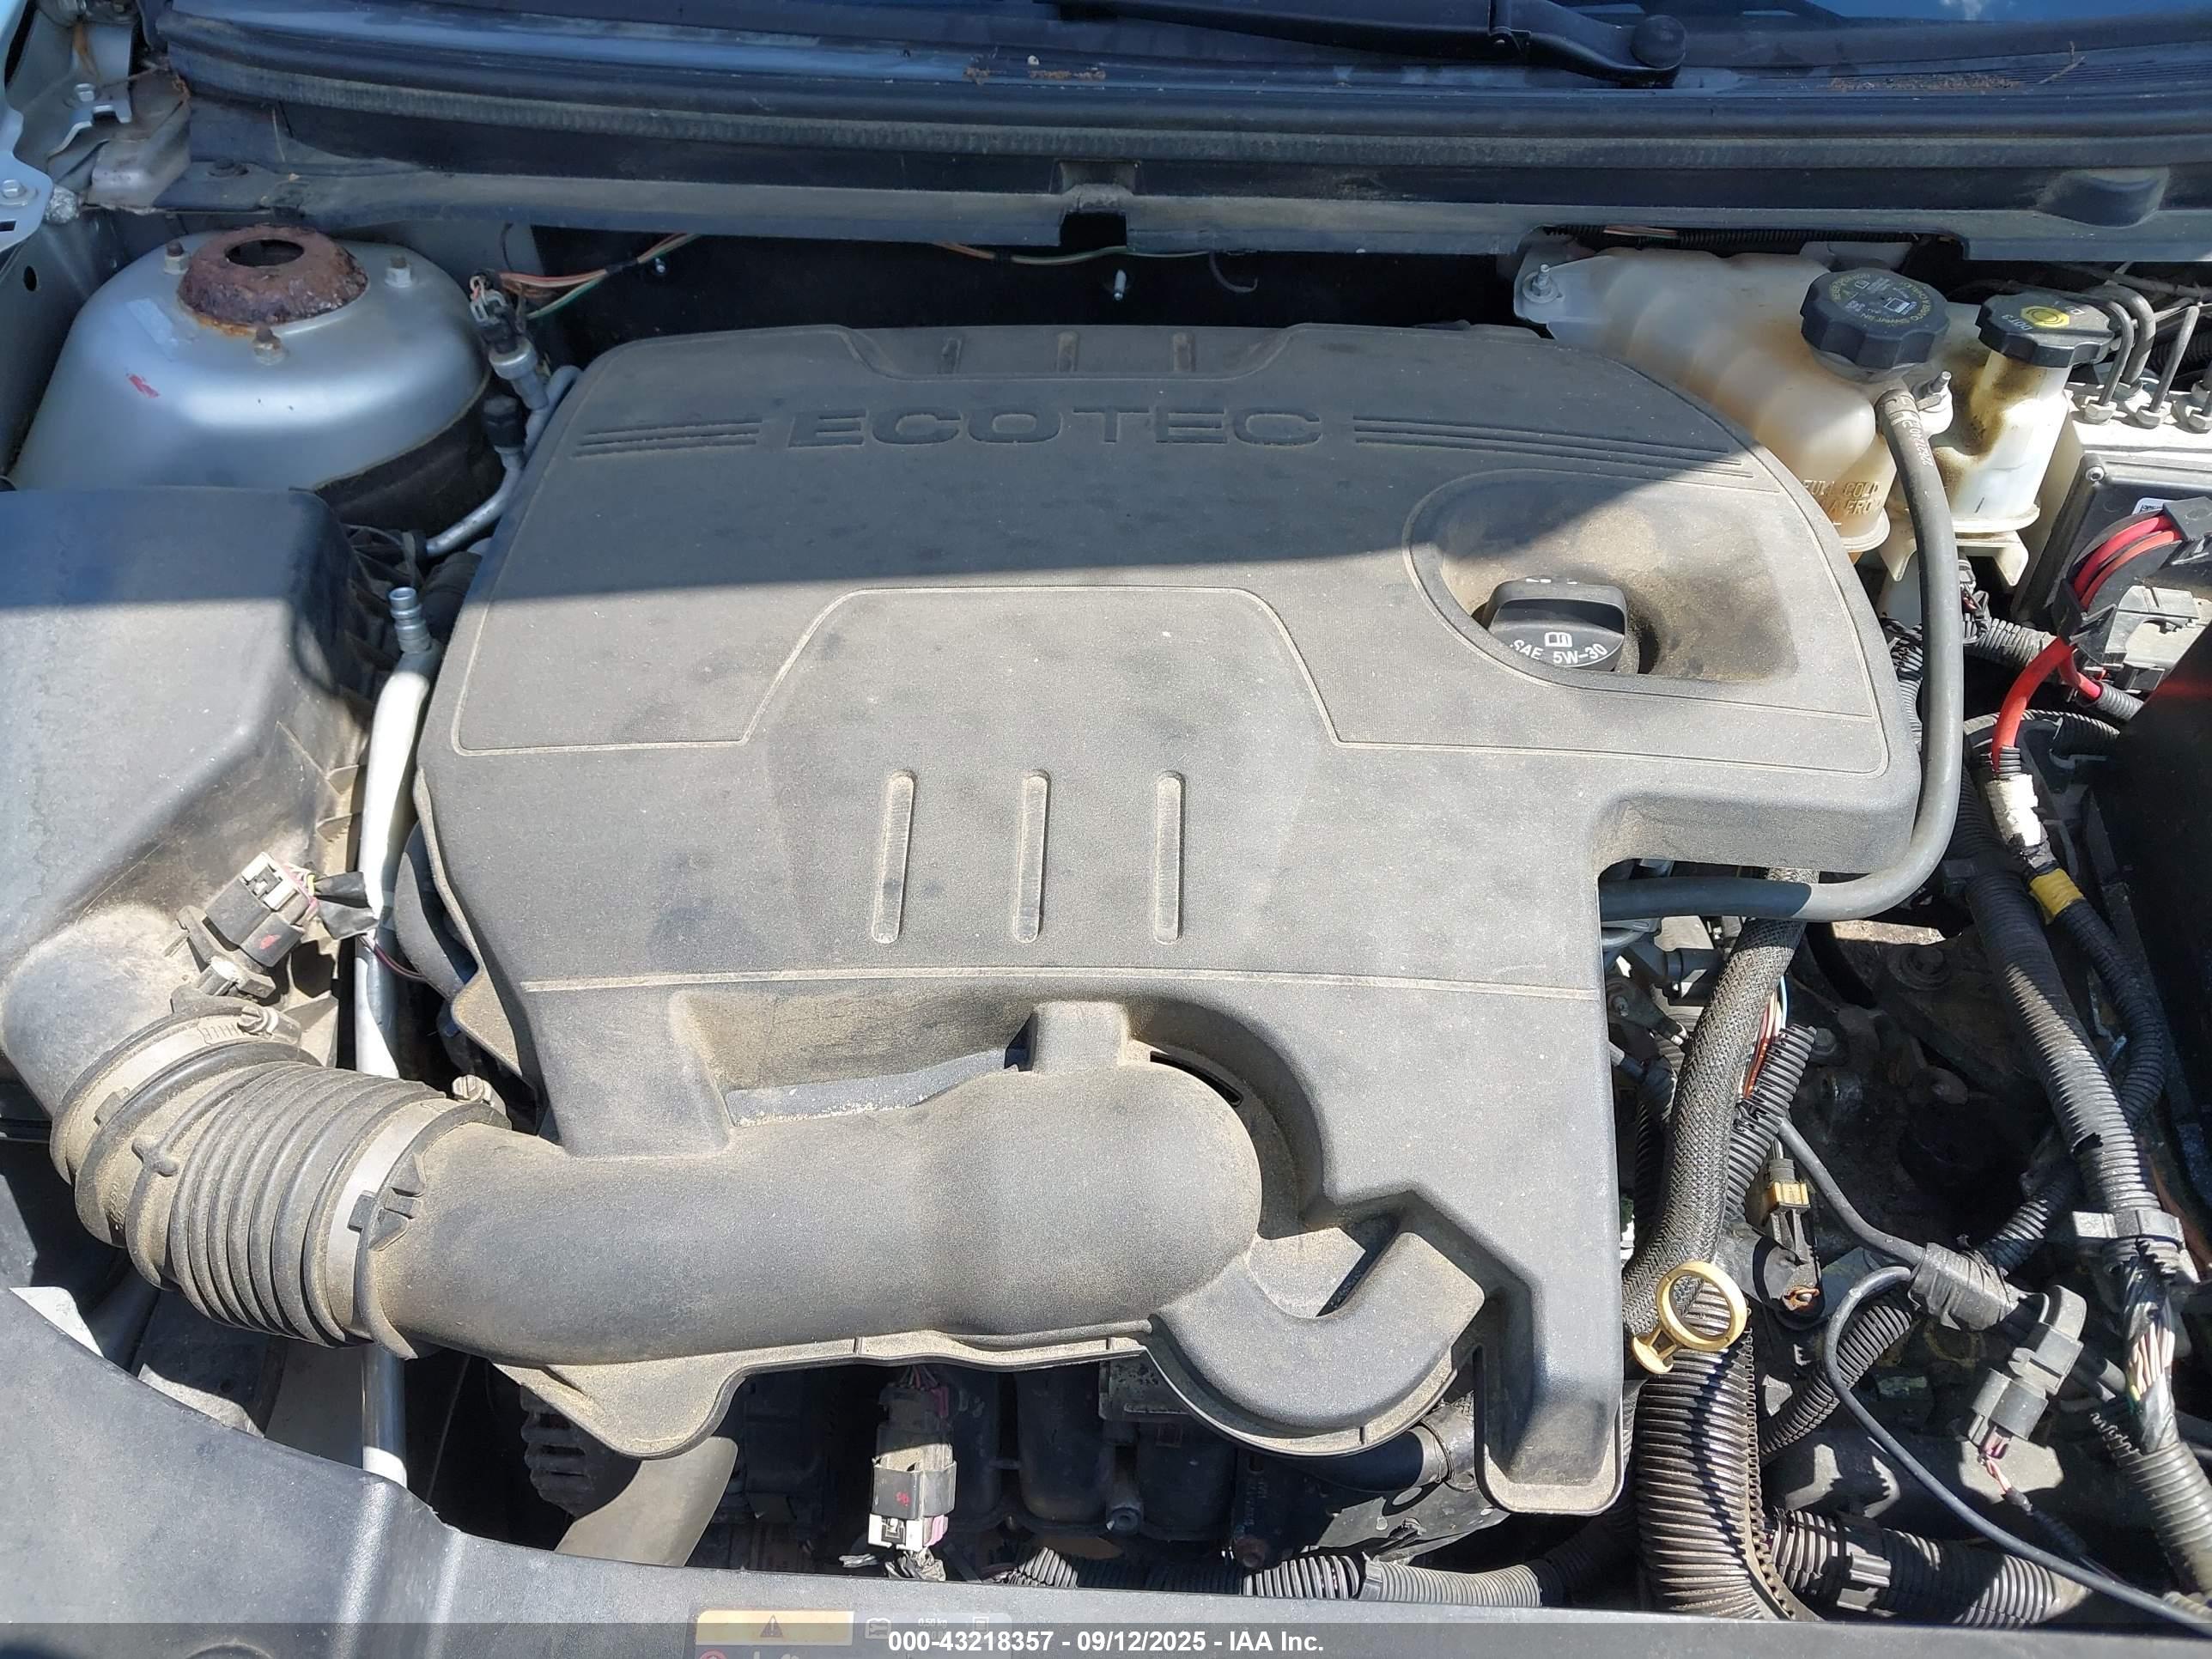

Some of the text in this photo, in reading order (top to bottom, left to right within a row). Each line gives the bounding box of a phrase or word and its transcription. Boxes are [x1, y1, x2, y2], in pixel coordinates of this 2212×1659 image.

[2008, 319, 2033, 331] DOT
[787, 406, 1323, 448] ECOTEC
[1844, 481, 1881, 498] COLD
[1510, 639, 1608, 665] SAE 5W-30
